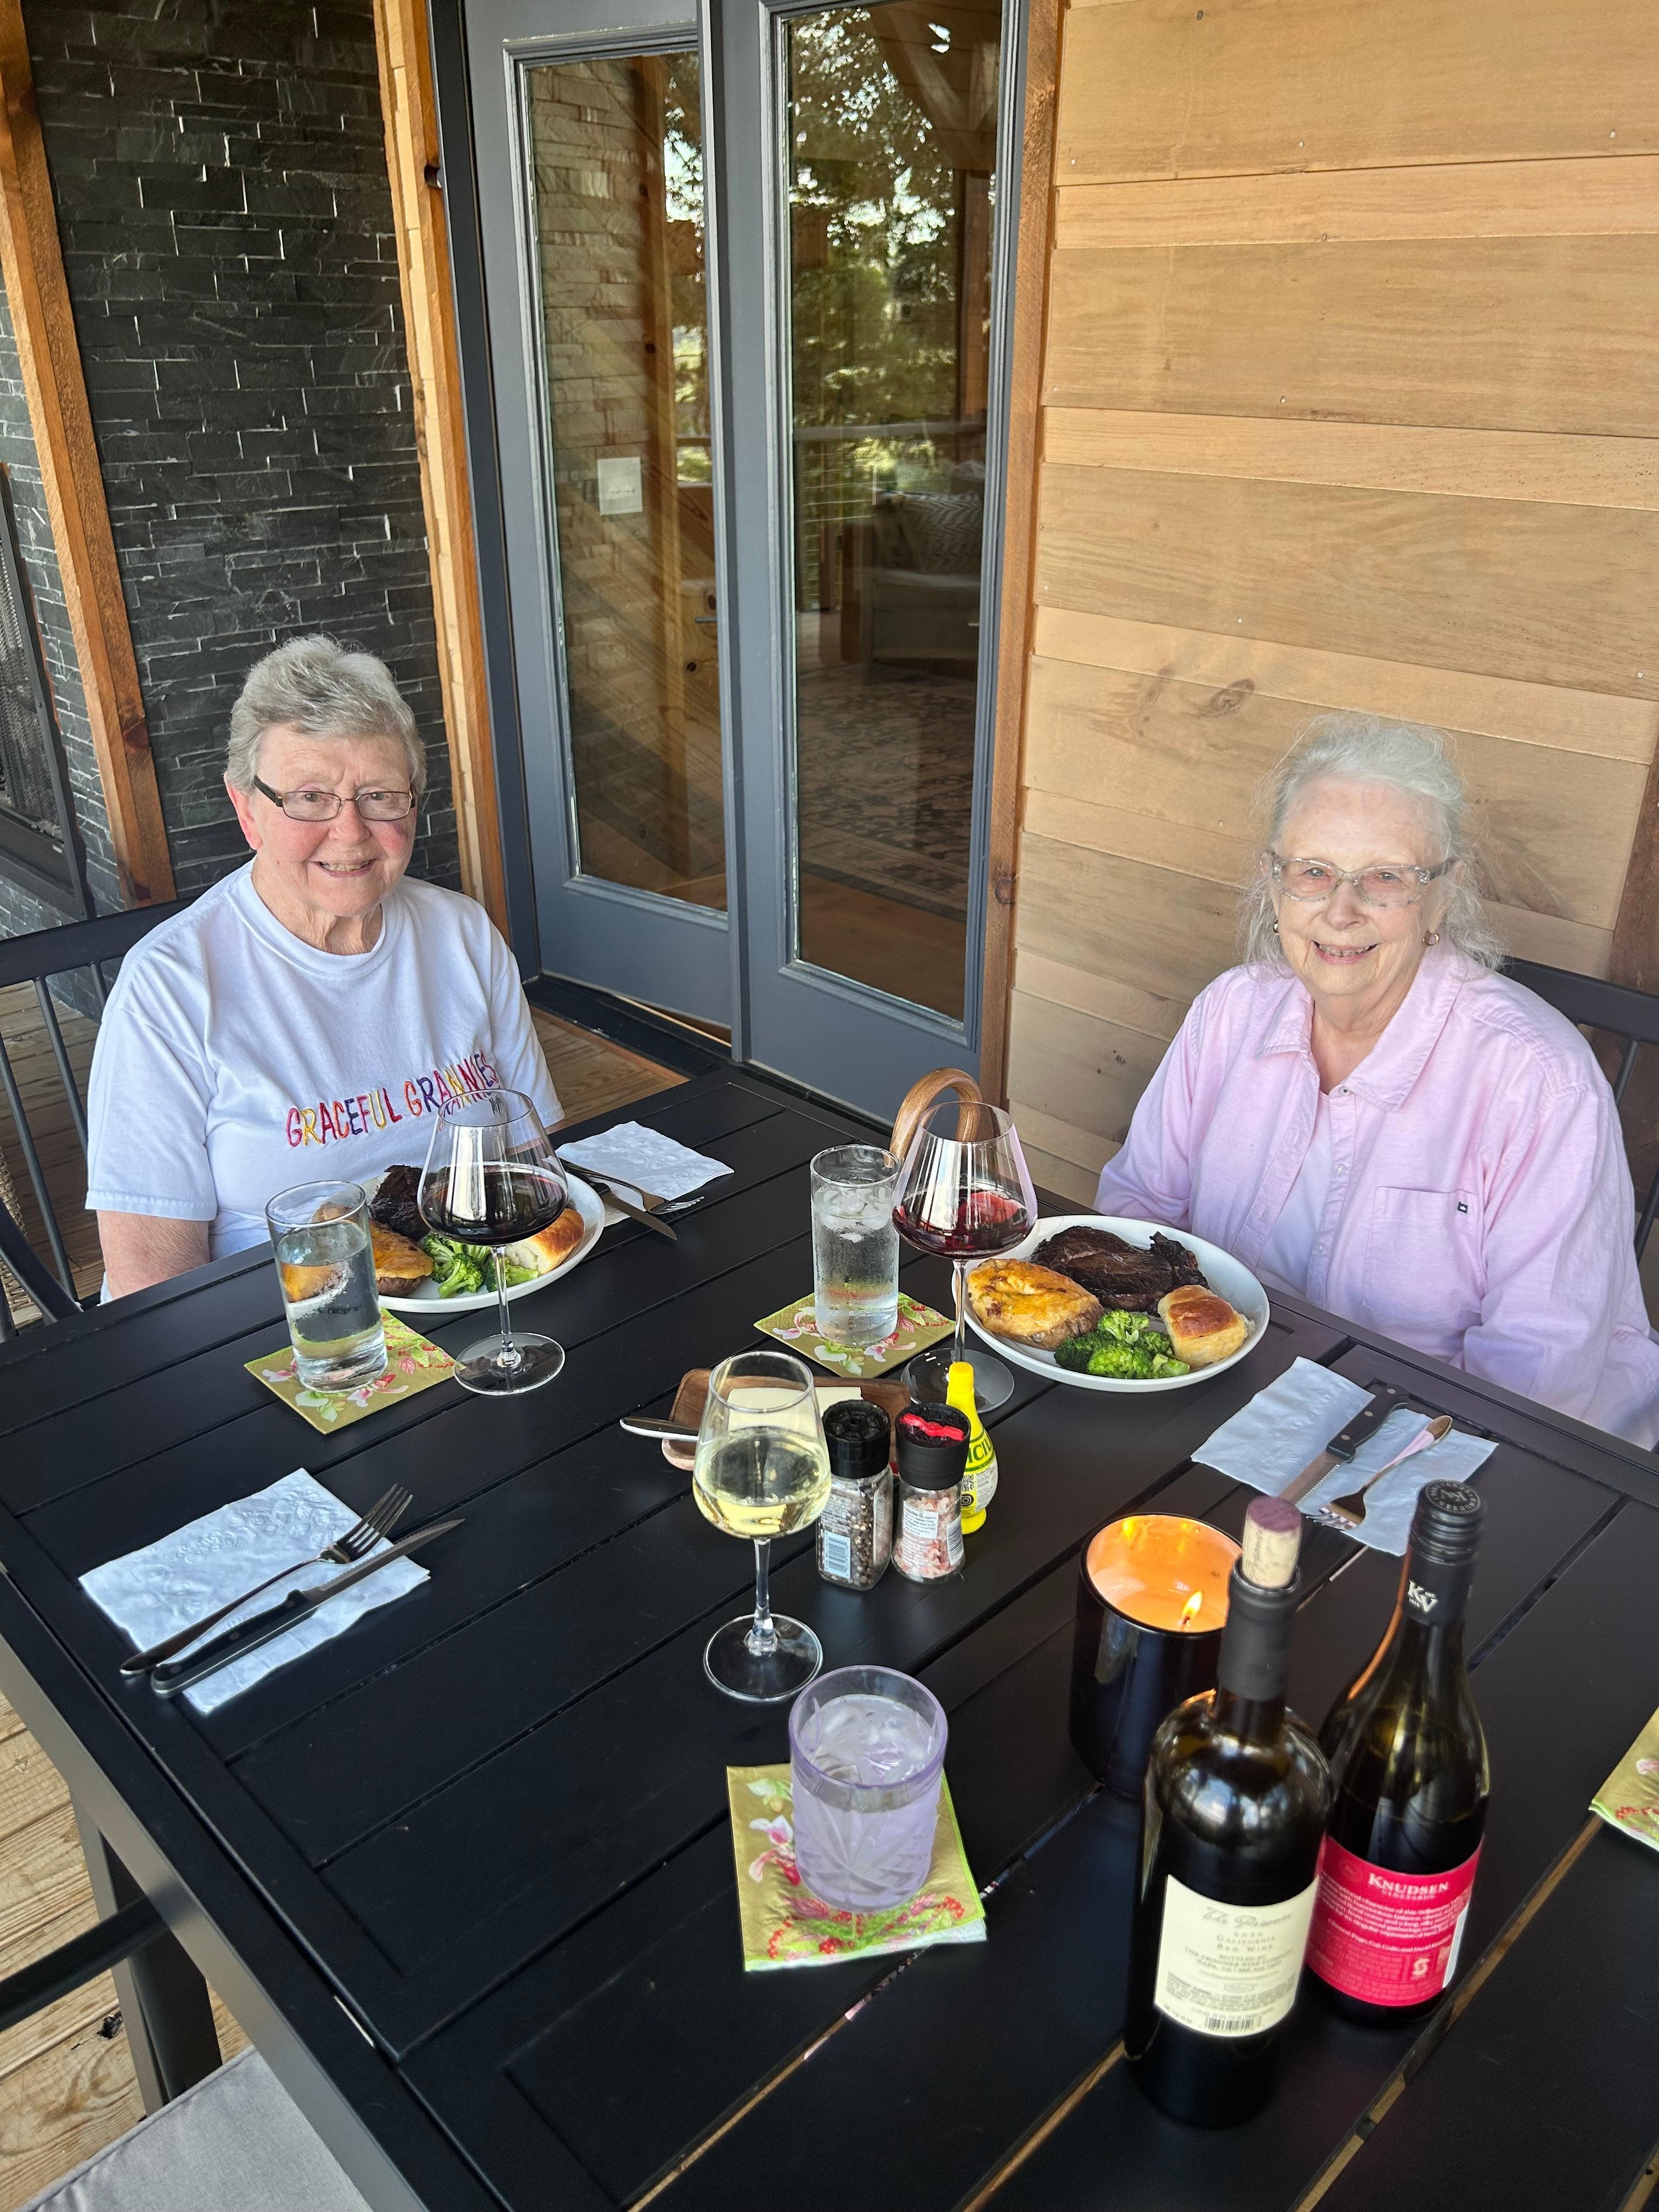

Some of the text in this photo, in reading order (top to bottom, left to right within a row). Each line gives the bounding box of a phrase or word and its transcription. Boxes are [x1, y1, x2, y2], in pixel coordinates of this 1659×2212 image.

[286, 1050, 499, 1147] GRACEFUL GRANNIES
[1369, 1873, 1449, 1895] KNUDSEN
